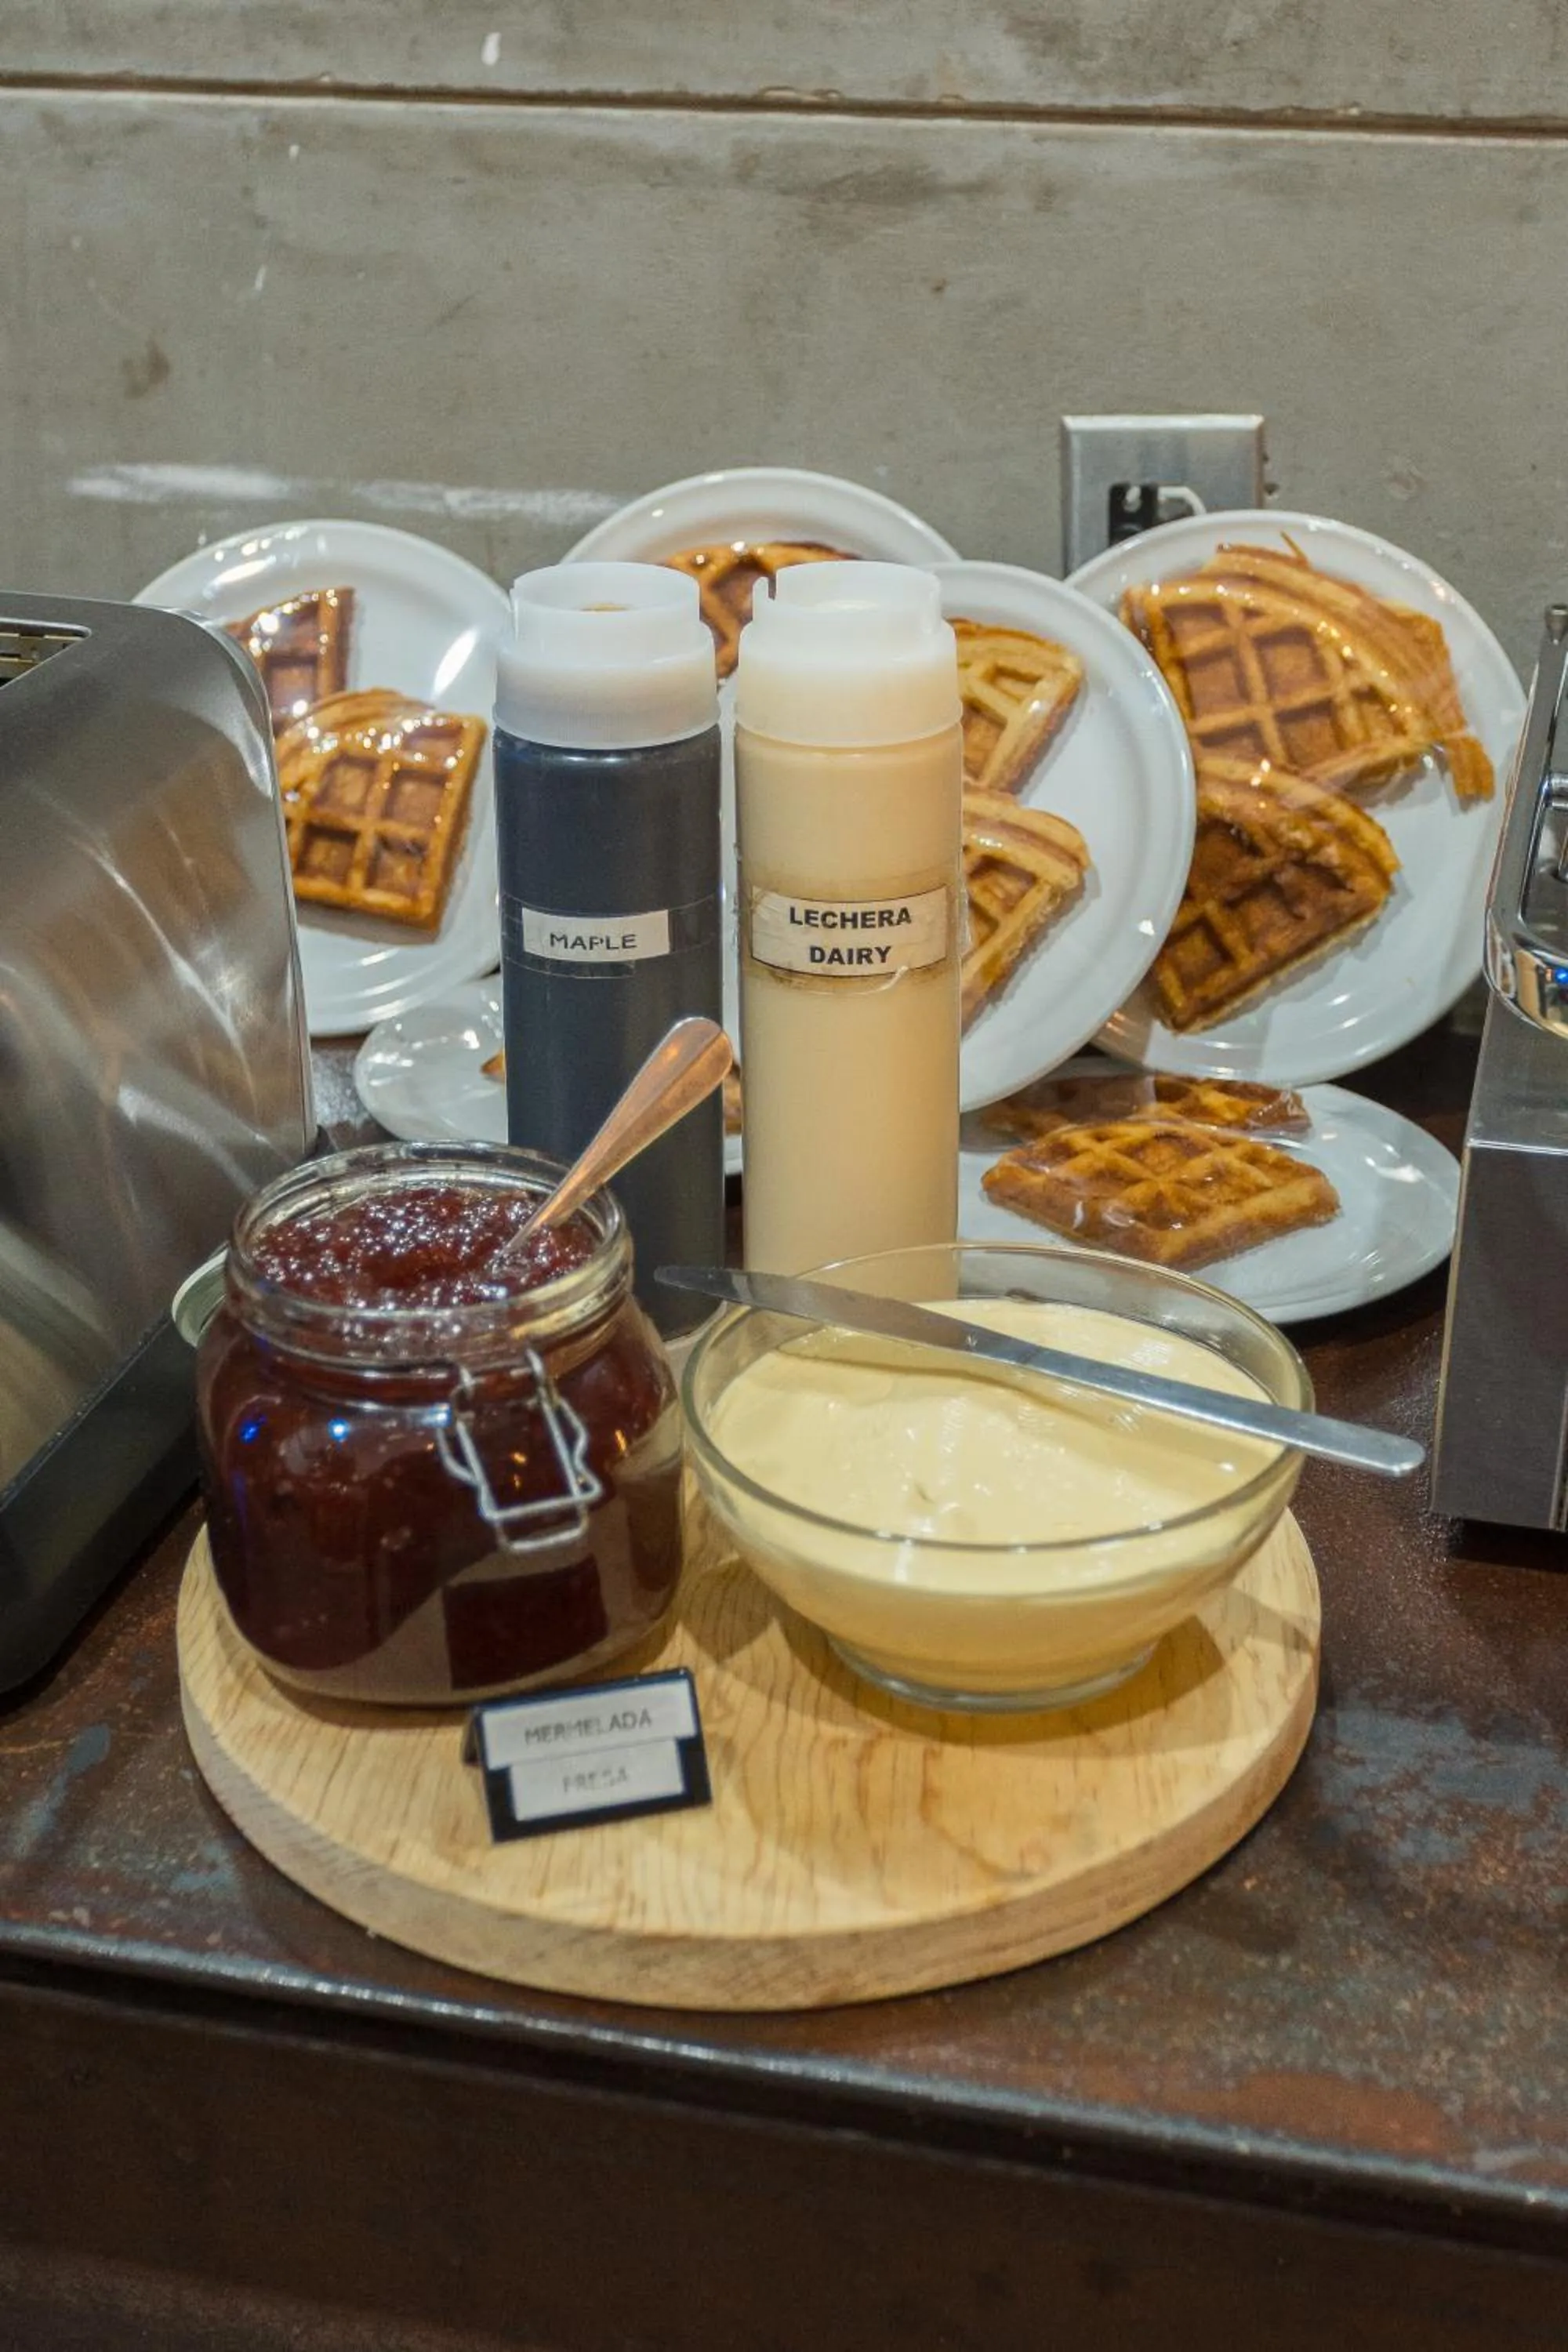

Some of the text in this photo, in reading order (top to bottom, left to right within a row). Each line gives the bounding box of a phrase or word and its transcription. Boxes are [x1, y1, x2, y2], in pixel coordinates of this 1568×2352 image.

[789, 906, 912, 929] LECHERA
[550, 932, 637, 950] MAPLE
[810, 946, 891, 965] DAIRY
[524, 1708, 652, 1744] MERMELADA
